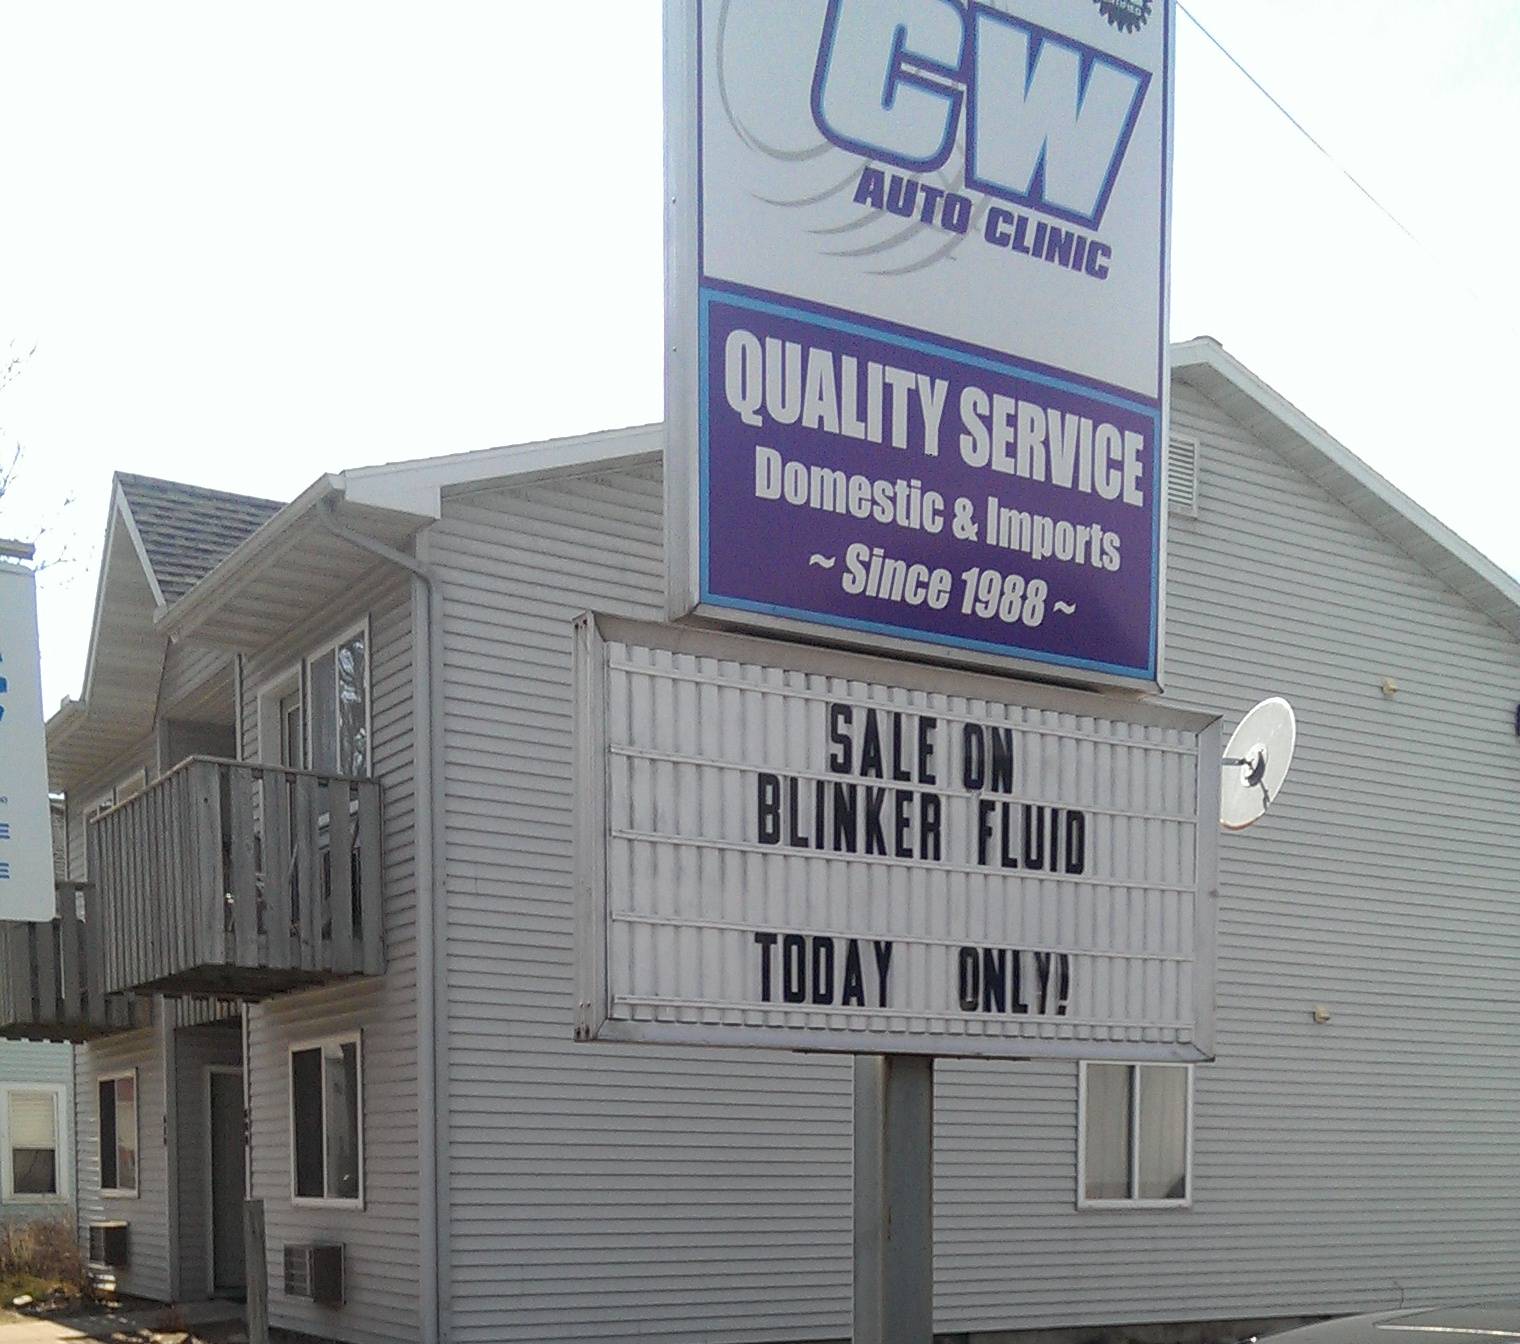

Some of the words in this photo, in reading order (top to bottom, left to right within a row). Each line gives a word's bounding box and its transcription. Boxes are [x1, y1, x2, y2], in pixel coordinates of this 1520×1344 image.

[853, 165, 972, 234] AUTO
[984, 208, 1112, 280] CLINIC
[724, 329, 949, 456] QUALITY
[959, 386, 1144, 506] SERVICE
[755, 445, 944, 533] Domestic
[953, 497, 978, 541] &
[987, 497, 1120, 572] Imports
[830, 703, 937, 785] SALE
[964, 723, 1013, 795] ON
[757, 773, 941, 861] BLINKER
[977, 801, 1086, 875] FLUID
[754, 932, 894, 1008] TODAY
[957, 947, 1070, 1016] ONLY!
